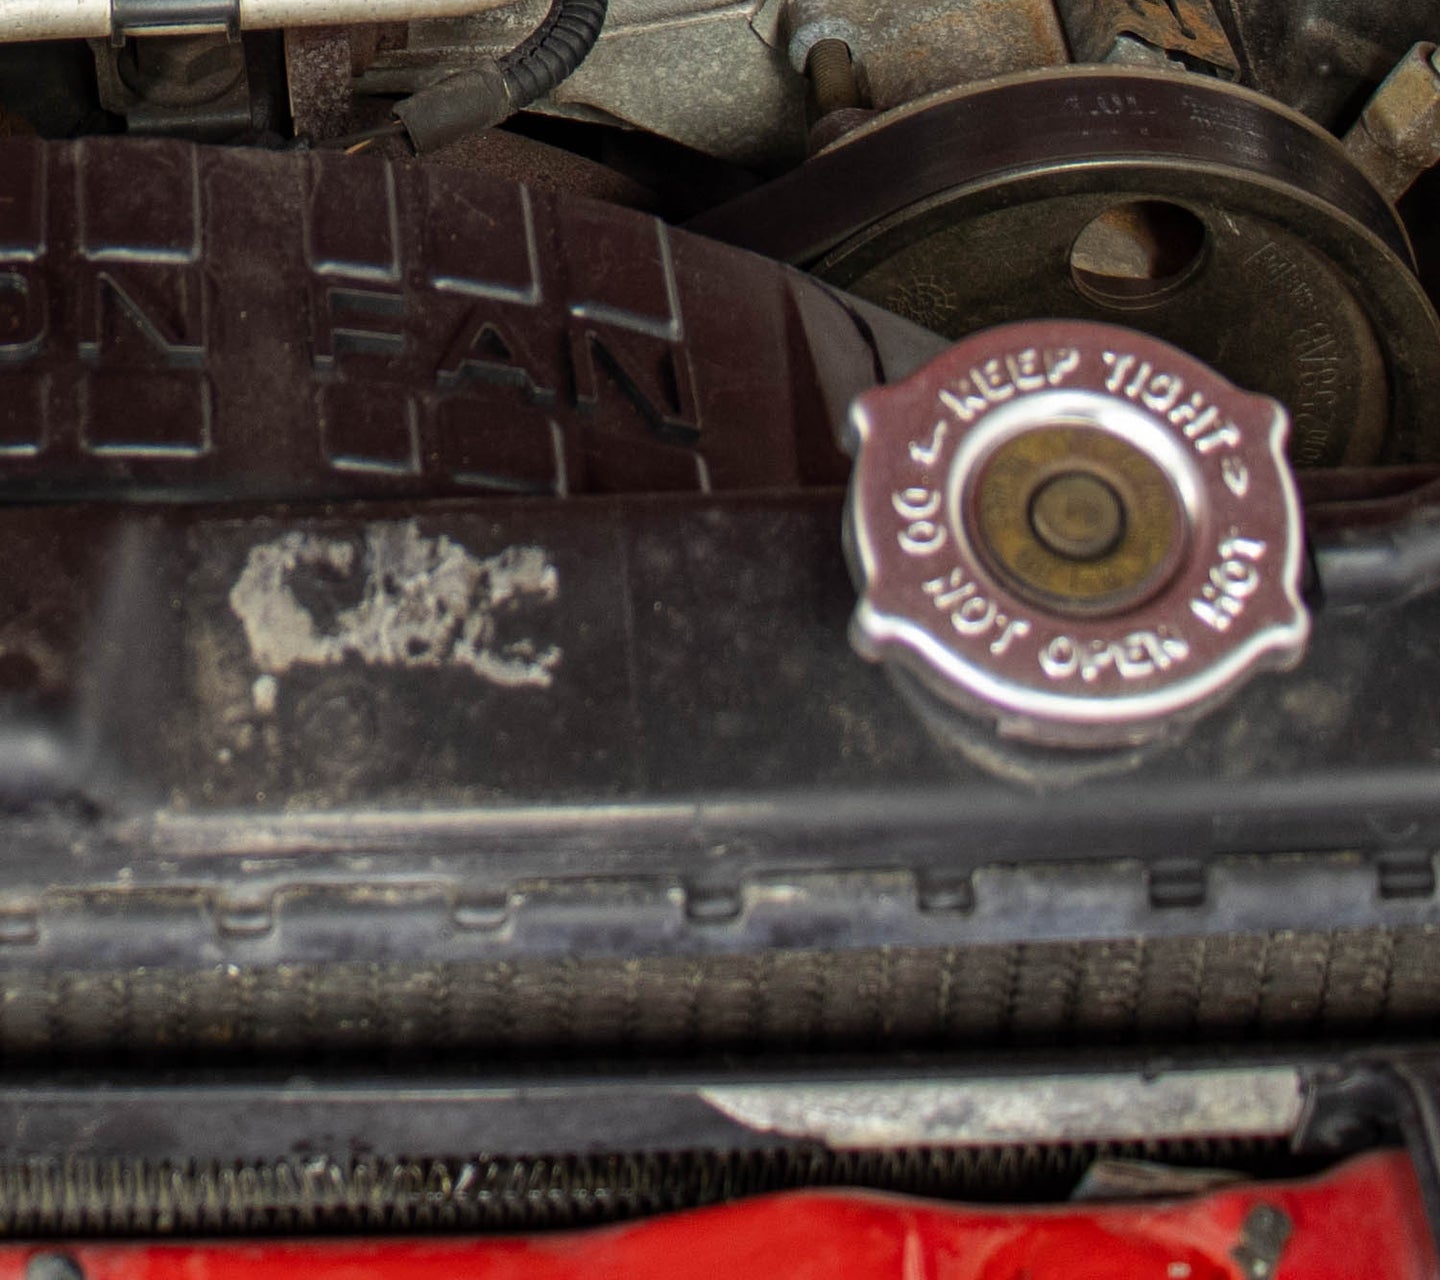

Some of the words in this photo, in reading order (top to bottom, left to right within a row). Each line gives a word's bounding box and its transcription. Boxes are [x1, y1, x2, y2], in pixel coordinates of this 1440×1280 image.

[314, 288, 702, 439] FAN
[939, 347, 1081, 421] KEEP
[1102, 350, 1242, 454] TIGHT
[891, 484, 947, 556] DO
[922, 566, 1032, 656] NOT
[1038, 626, 1190, 683] OPEN
[1189, 530, 1267, 632] HOT
